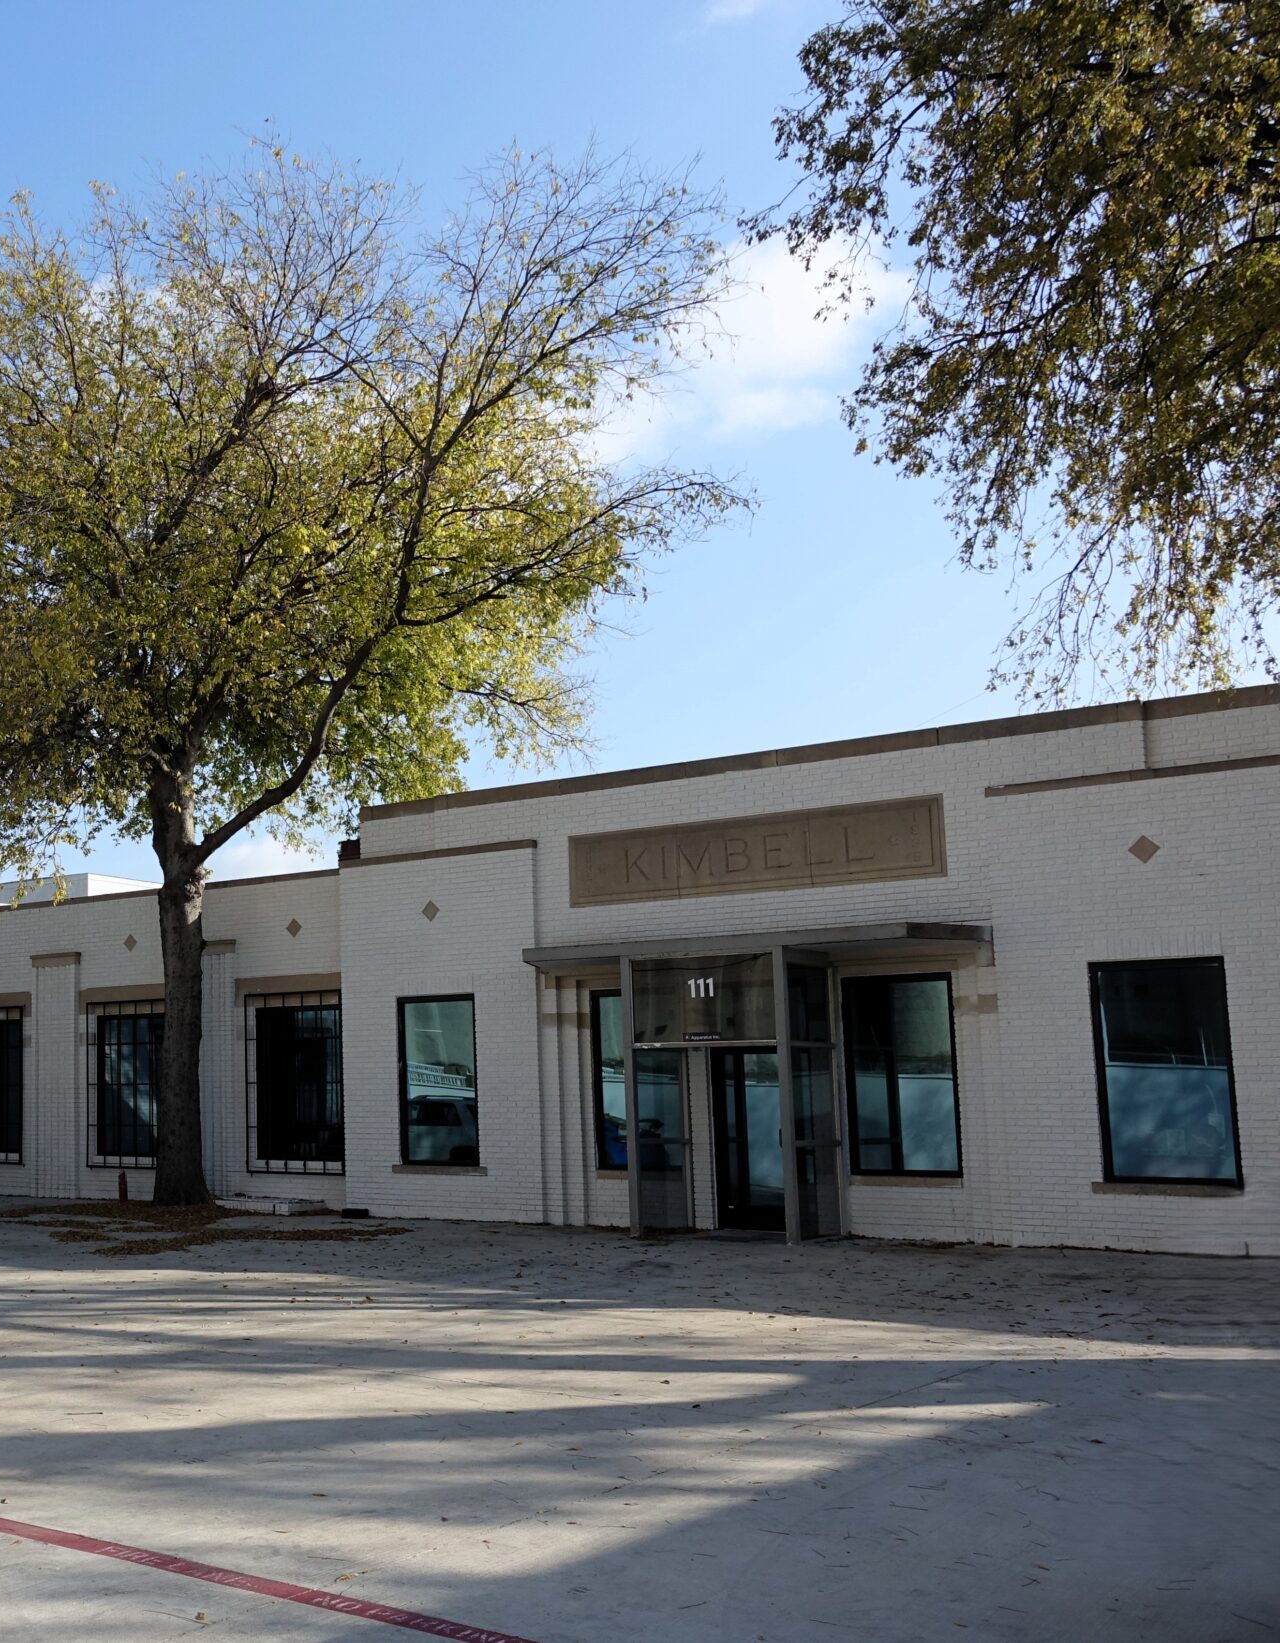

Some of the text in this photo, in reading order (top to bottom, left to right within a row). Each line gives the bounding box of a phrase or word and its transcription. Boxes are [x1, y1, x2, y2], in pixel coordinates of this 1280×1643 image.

[624, 826, 875, 885] KIMBELL
[687, 977, 714, 998] 111
[96, 1546, 162, 1565] FIRE
[313, 1596, 363, 1611] NO
[366, 1608, 507, 1643] PARKIN
